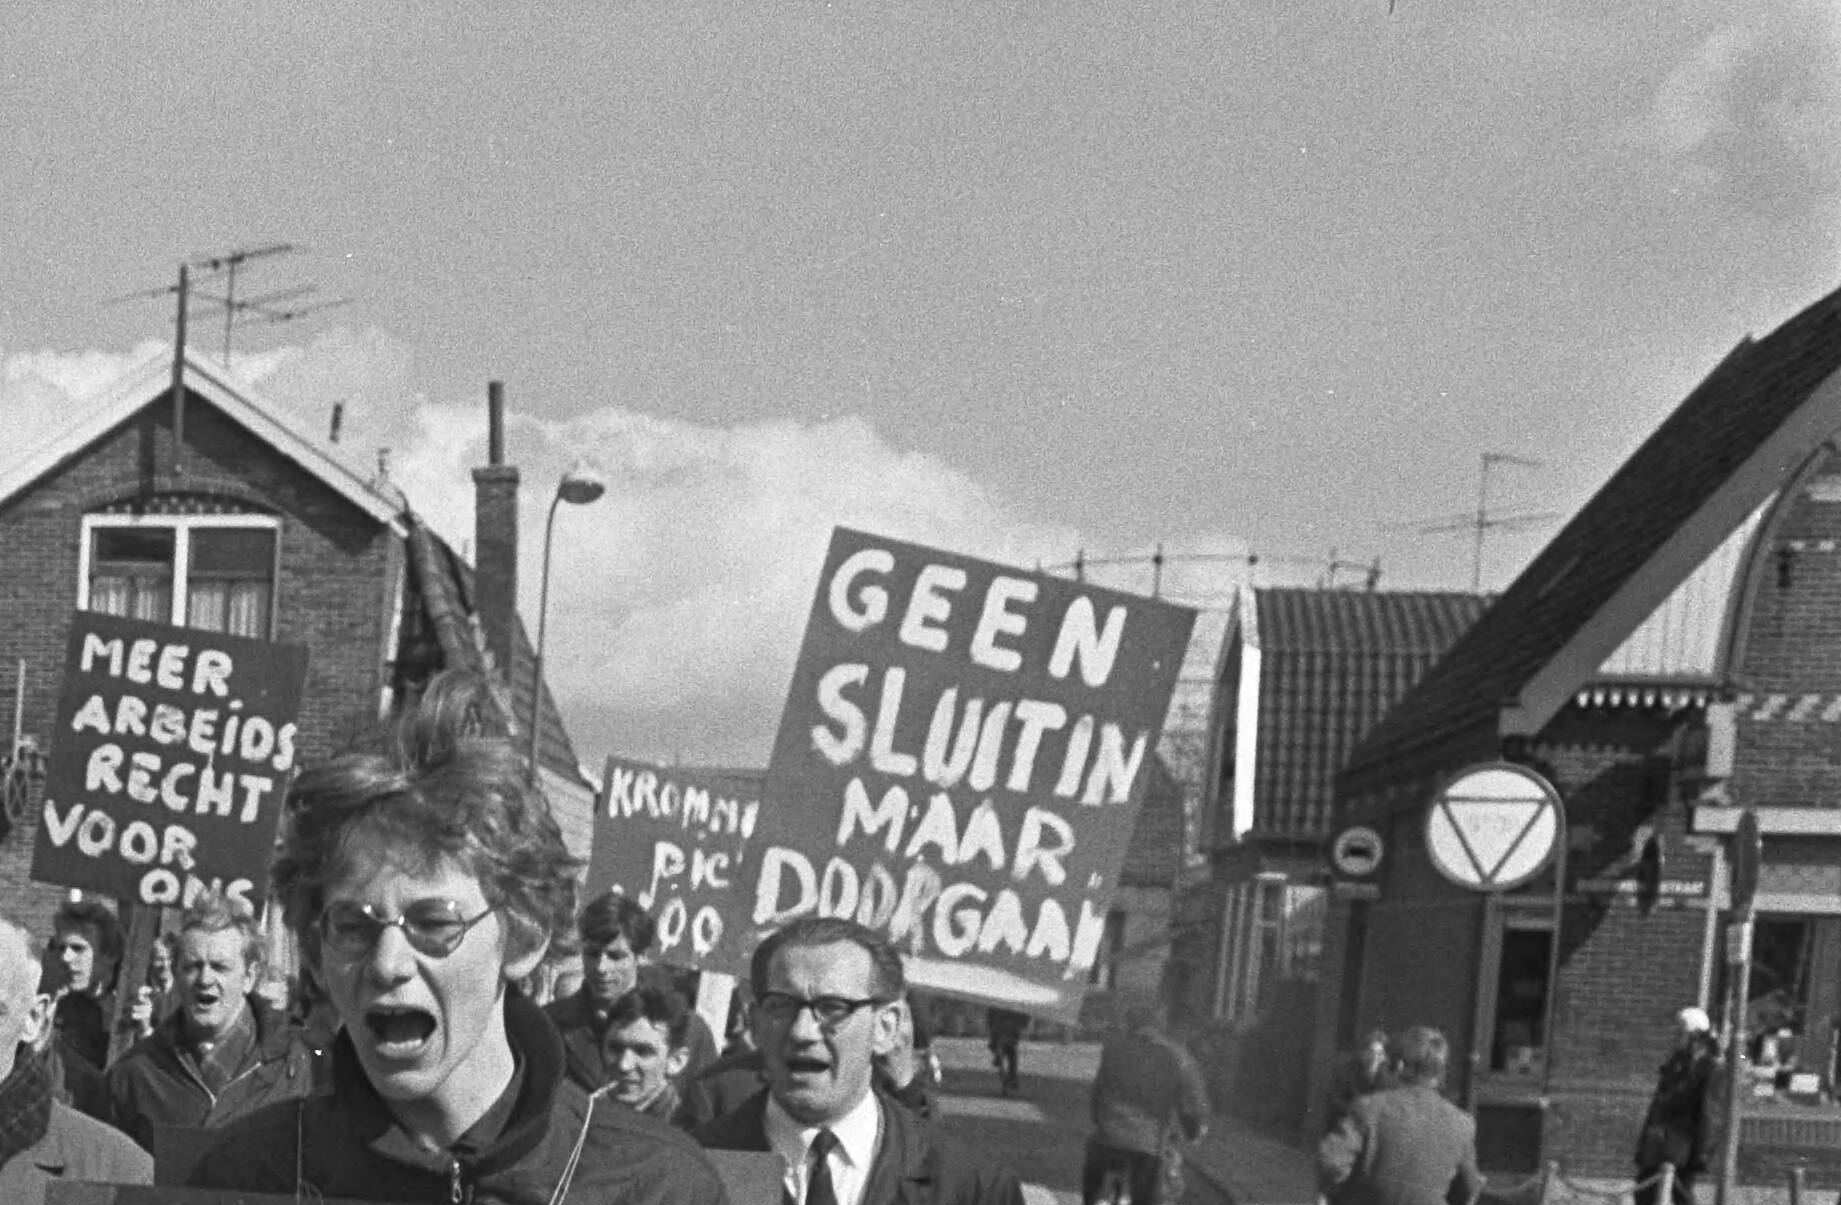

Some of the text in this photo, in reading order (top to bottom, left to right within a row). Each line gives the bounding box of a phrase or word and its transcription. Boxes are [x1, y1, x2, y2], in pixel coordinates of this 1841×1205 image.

[828, 548, 1127, 687] GEEN
[80, 632, 233, 697] MEER
[72, 695, 297, 772] ARBEIDS
[810, 663, 1150, 807] SLUITIN
[85, 743, 273, 823] RECHT
[43, 799, 197, 871] VOOR
[837, 778, 1075, 886] MAAR
[139, 868, 255, 917] ONS
